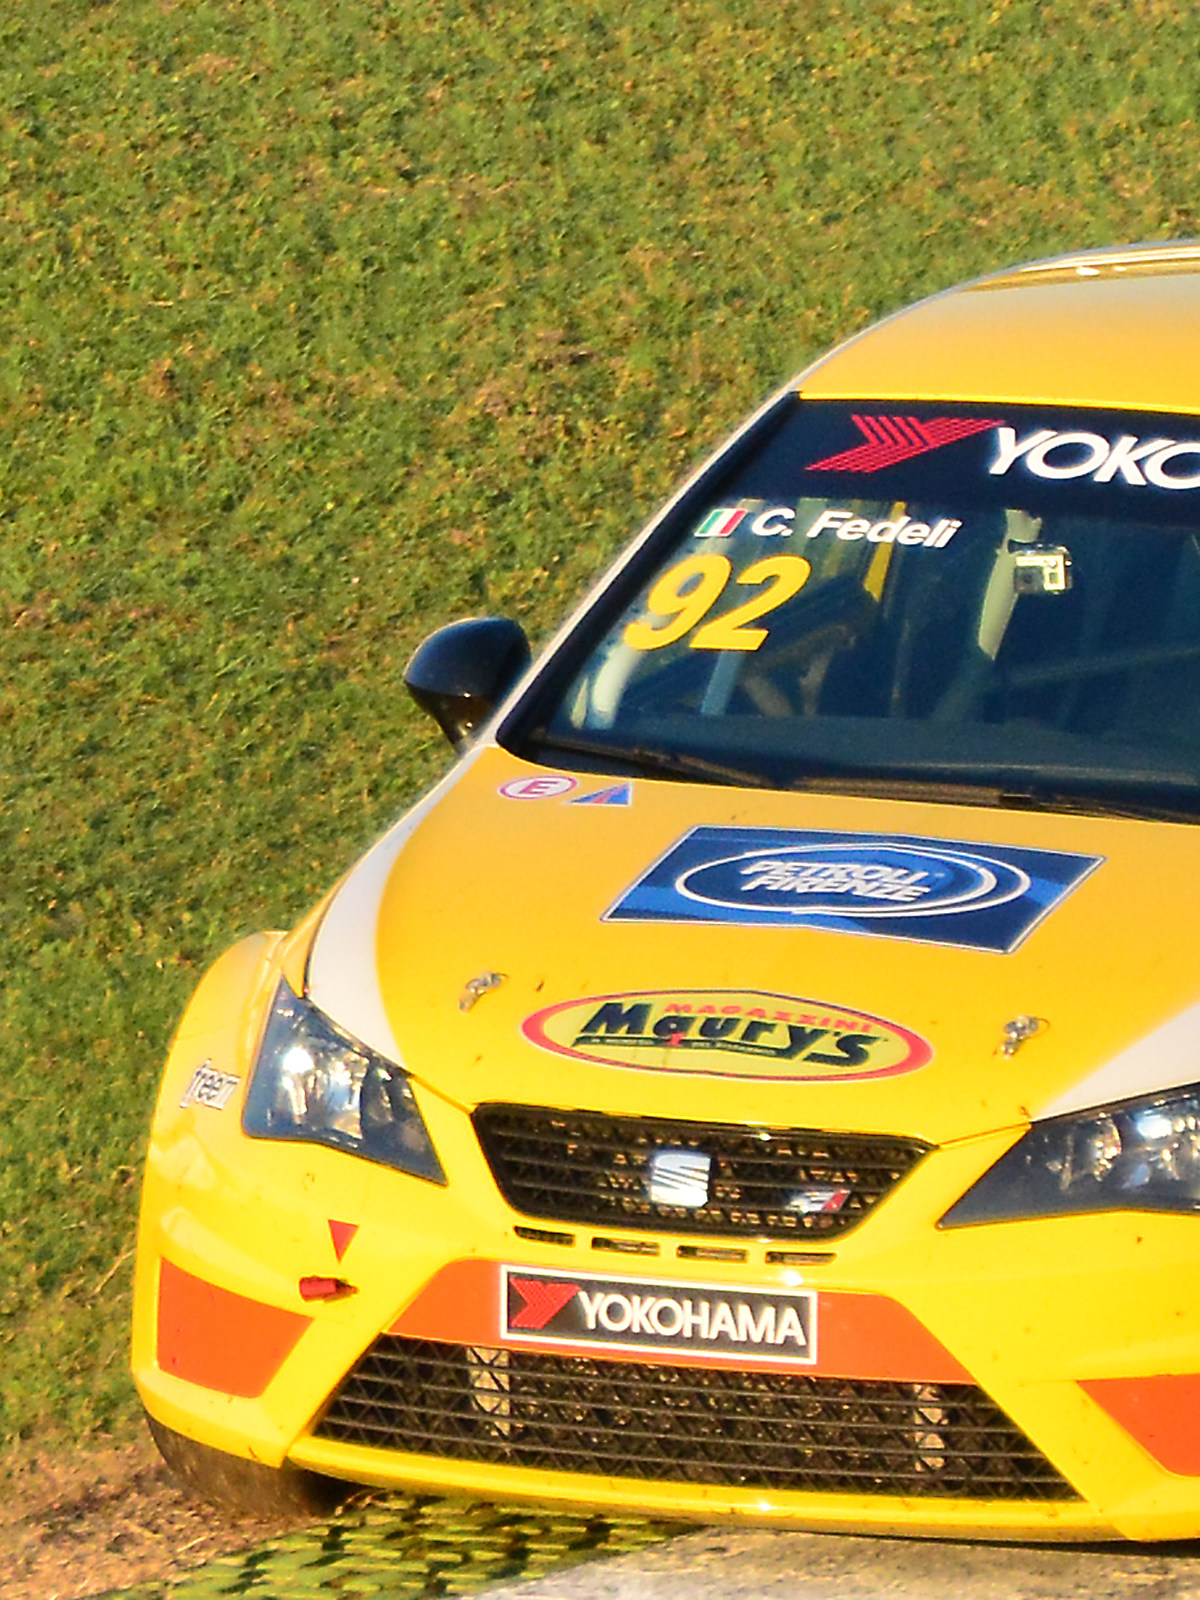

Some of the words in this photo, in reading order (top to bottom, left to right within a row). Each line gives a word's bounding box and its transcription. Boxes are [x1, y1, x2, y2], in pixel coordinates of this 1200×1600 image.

[751, 508, 795, 538] C.
[806, 510, 963, 549] Fedeli
[622, 553, 811, 651] 92
[741, 875, 931, 902] FIRENZE
[581, 1002, 880, 1067] Maury's
[664, 1003, 873, 1032] MAGAZZINI
[579, 1290, 807, 1346] YOKOHAMA
